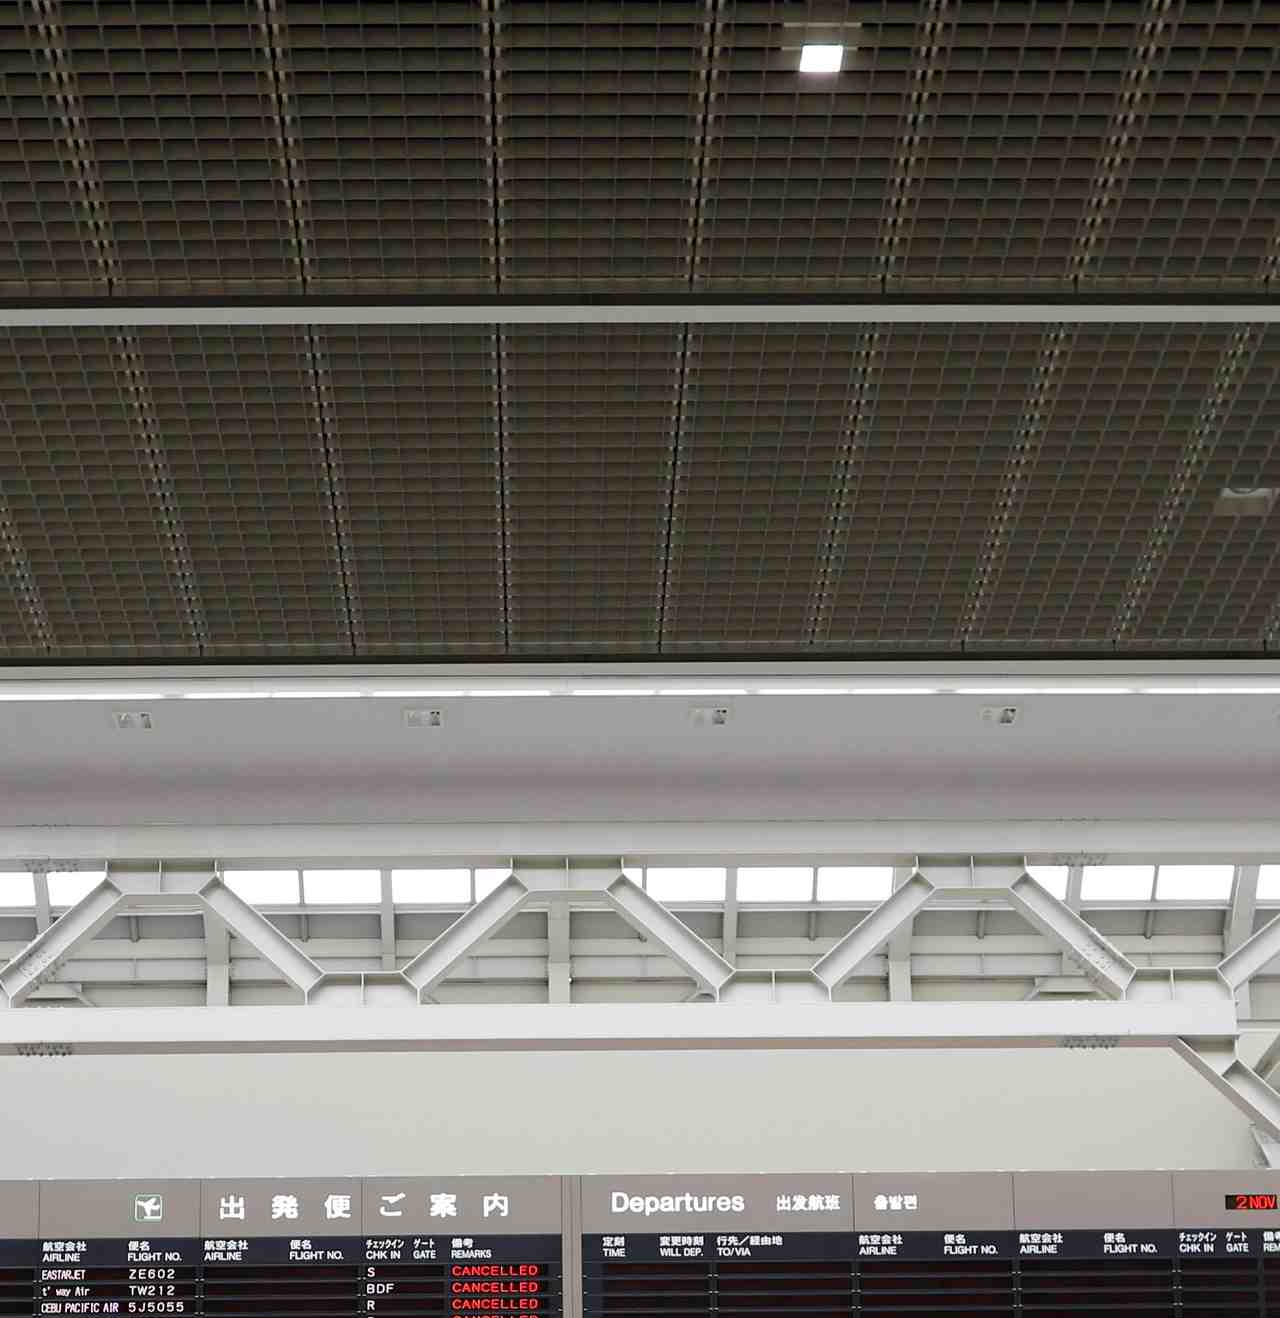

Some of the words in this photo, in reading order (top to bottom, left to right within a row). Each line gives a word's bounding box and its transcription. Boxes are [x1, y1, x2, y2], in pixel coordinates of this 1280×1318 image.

[219, 1193, 510, 1220] 出発便ご案内
[611, 1191, 745, 1216] Departures
[1236, 1196, 1247, 1209] 2
[1249, 1196, 1277, 1209] NOV
[602, 1248, 626, 1257] TIME
[659, 1248, 682, 1257] WILL
[683, 1247, 704, 1257] DEP.
[716, 1247, 752, 1257] TO/VIA
[859, 1246, 897, 1256] AIRLINE
[1226, 1242, 1249, 1253] GATE
[42, 1252, 81, 1263] AIRLINE
[127, 1252, 163, 1262] FLIGHT
[165, 1252, 183, 1262] NO.
[204, 1251, 242, 1261] AIRLINE
[289, 1250, 324, 1260] FLIGHT
[326, 1250, 344, 1260] NO.
[366, 1249, 388, 1260] CHK
[390, 1249, 401, 1260] IN
[413, 1249, 437, 1260] GATE
[451, 1249, 492, 1259] REMARKS
[128, 1268, 175, 1280] ZE602
[452, 1264, 538, 1276] CANCELLED
[128, 1285, 175, 1296] TW212
[128, 1301, 184, 1313] 5J5055
